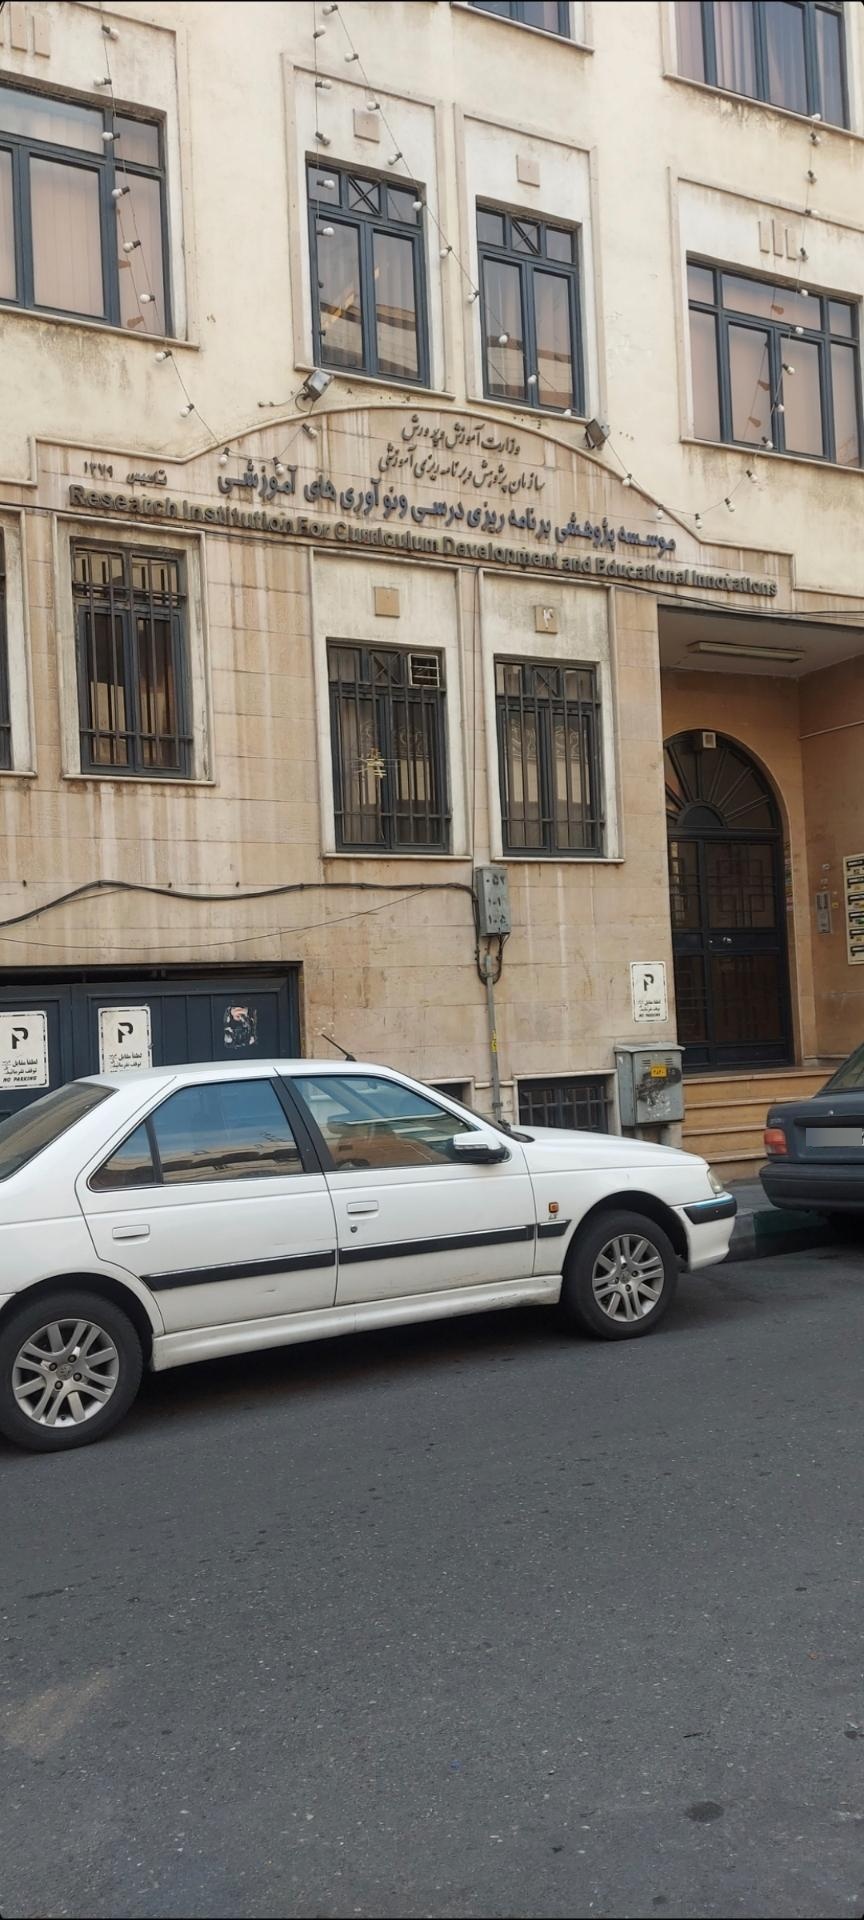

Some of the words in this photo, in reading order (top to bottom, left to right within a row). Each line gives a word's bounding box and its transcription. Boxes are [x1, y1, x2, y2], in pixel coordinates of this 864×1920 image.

[445, 422, 485, 450] آموزش
[481, 435, 520, 456] وزارت
[378, 442, 417, 473] آموزشی
[217, 459, 297, 500] آموزشی
[304, 474, 337, 502] های
[473, 459, 508, 493] پژوهش
[508, 472, 546, 495] سازمان
[410, 500, 465, 527] درسی
[467, 501, 505, 534] ریزی
[508, 507, 551, 540] برنامه
[69, 484, 177, 518] Research
[182, 499, 294, 534] Institution
[297, 516, 330, 538] For
[334, 521, 438, 552] Curriculum
[442, 535, 558, 568] Development
[562, 555, 592, 574] and
[595, 556, 689, 585] Educational
[692, 569, 778, 597] Innovations
[555, 512, 616, 552] پژوهشی
[617, 526, 676, 559] موسسه
